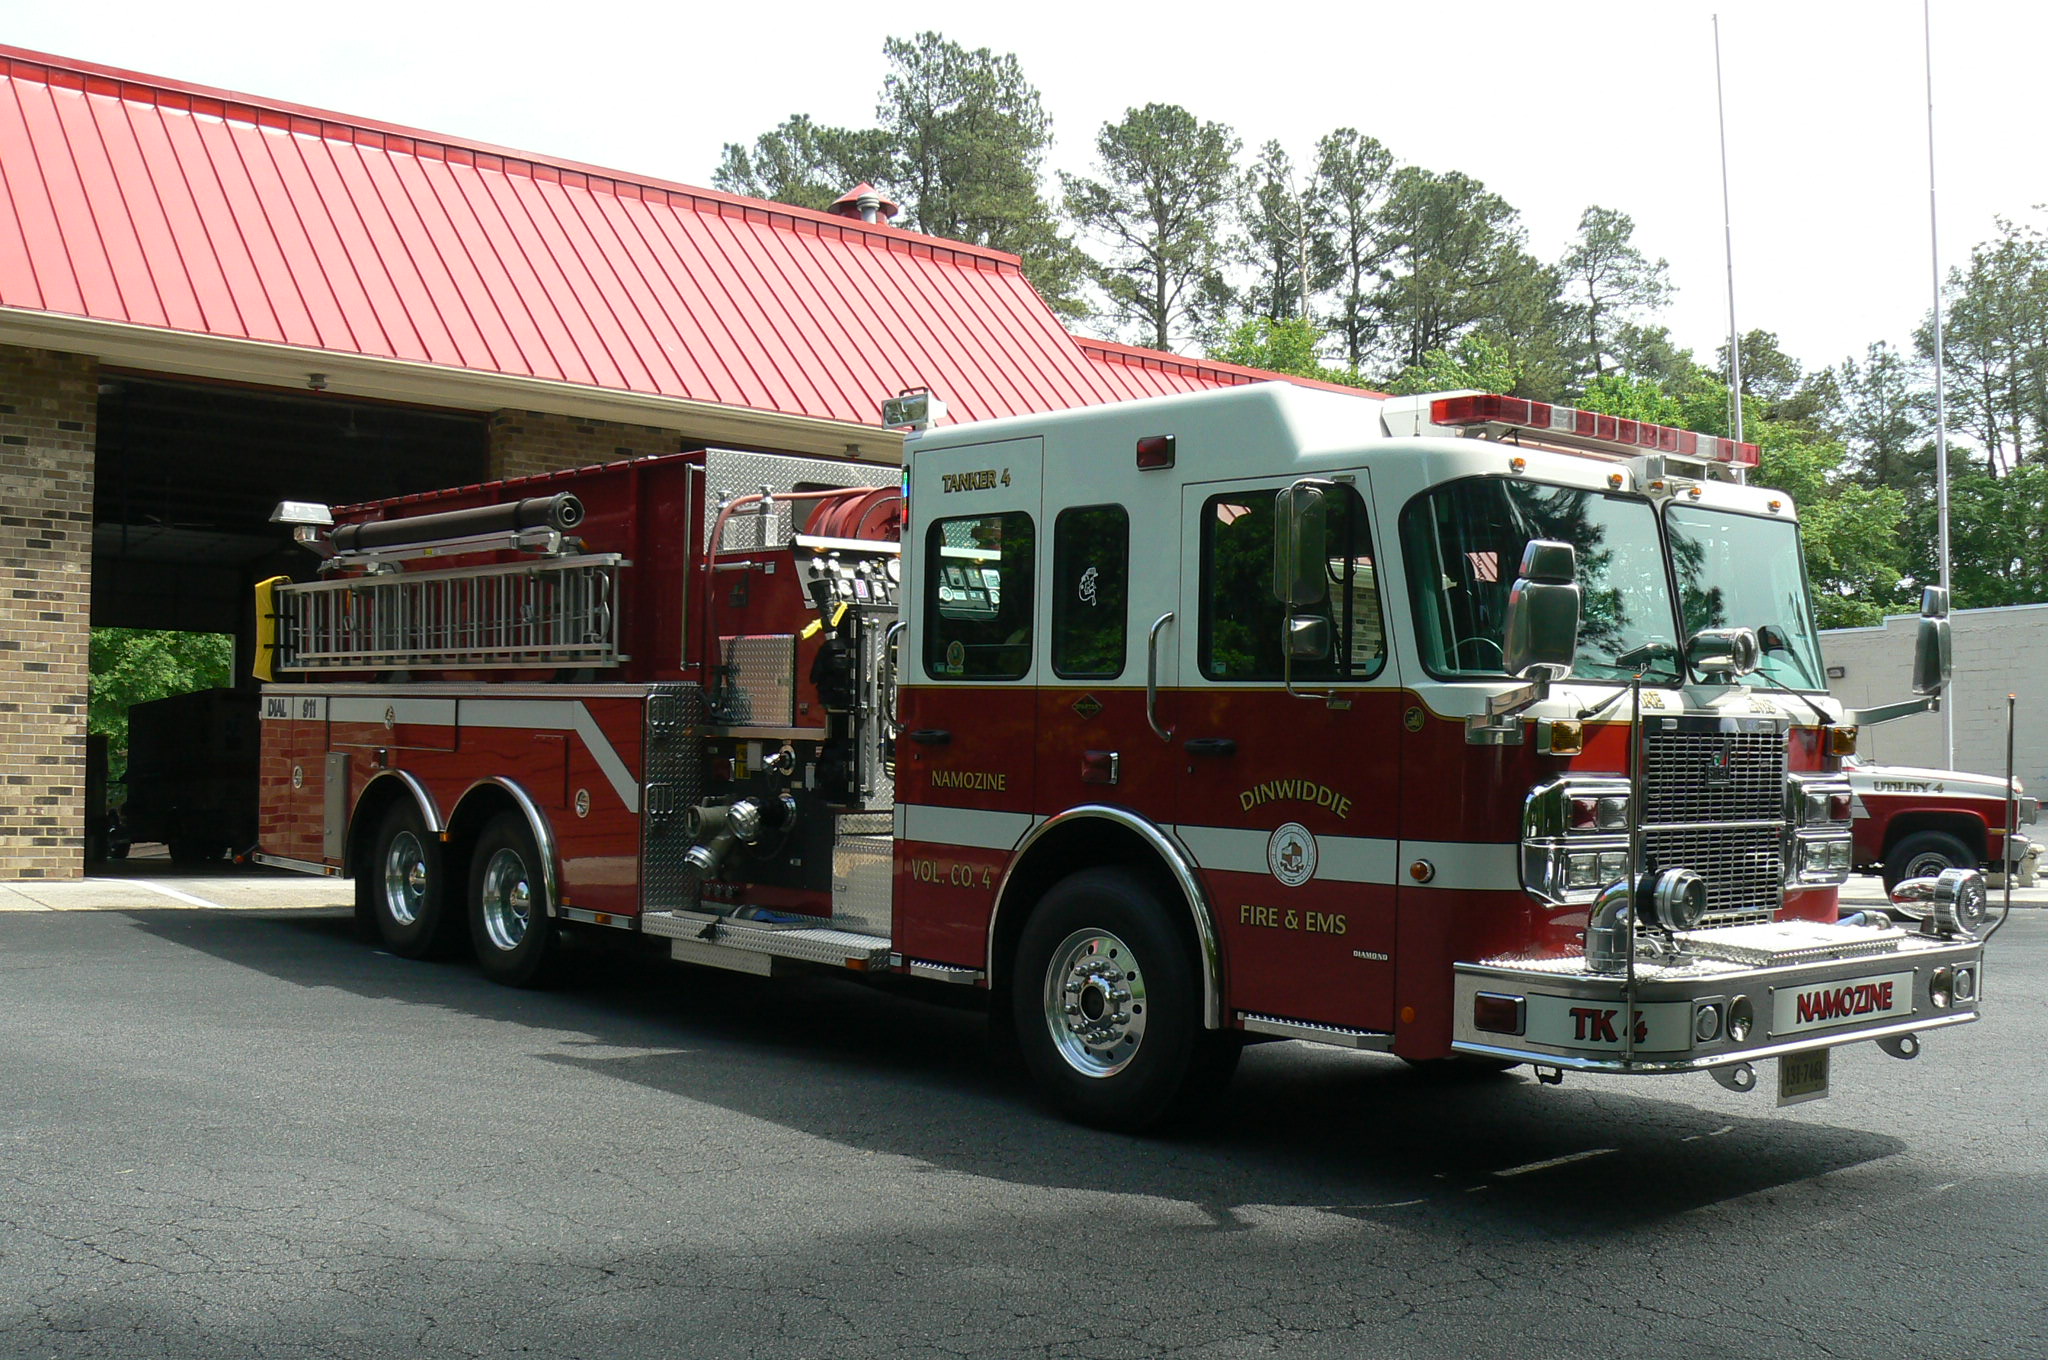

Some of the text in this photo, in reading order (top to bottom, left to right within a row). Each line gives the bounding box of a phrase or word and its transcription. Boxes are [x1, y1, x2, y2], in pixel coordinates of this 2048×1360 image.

[942, 468, 1011, 493] TANKER 4
[267, 698, 316, 718] DIAL 911
[931, 769, 1006, 791] NAMOZINE
[1873, 781, 1944, 793] UTILITY 4
[1239, 779, 1352, 819] DINWIDDIE
[911, 858, 991, 889] VOL. CO. 4
[1240, 904, 1347, 935] FIRE & EMS
[1352, 950, 1389, 961] DIAMOND
[1795, 980, 1894, 1025] NAMOZINE
[1569, 1007, 1619, 1043] TK
